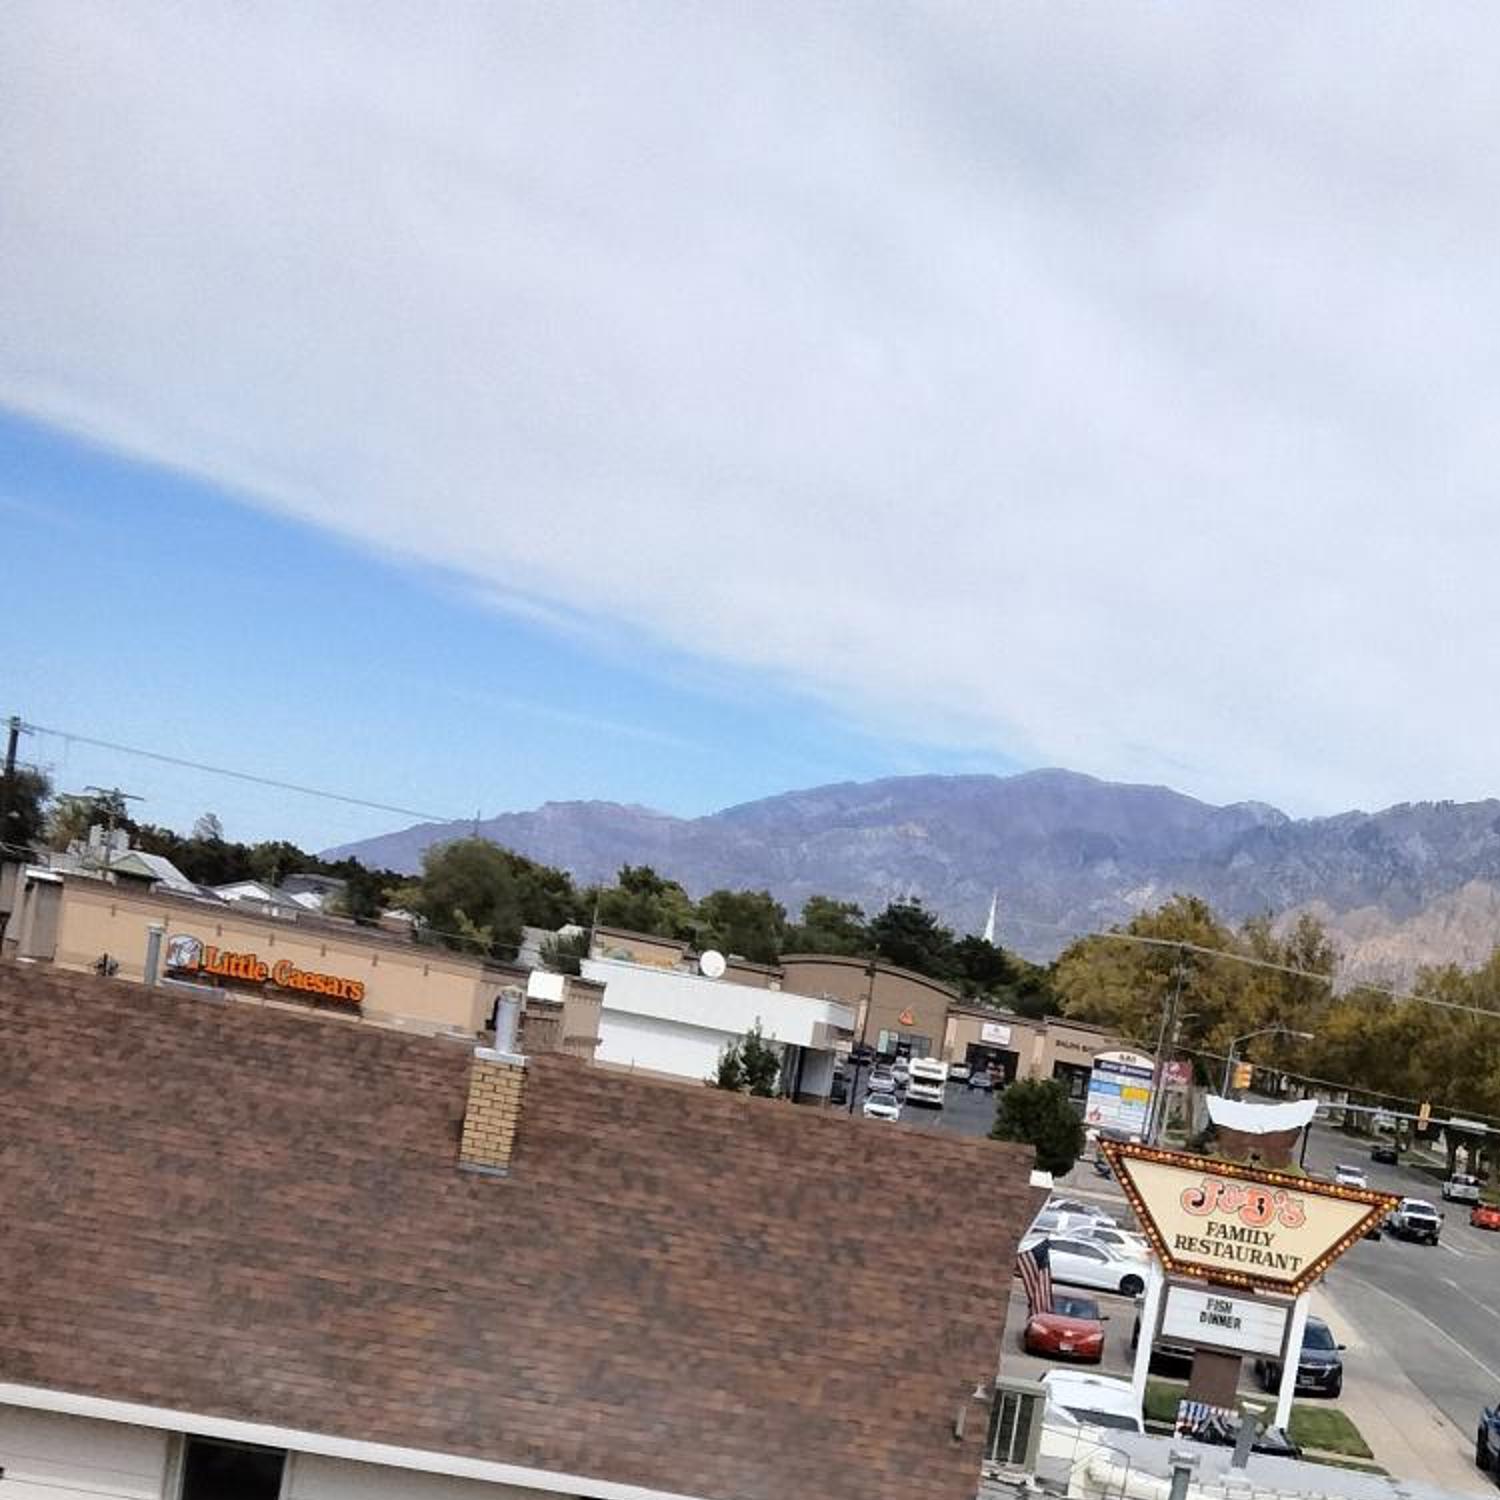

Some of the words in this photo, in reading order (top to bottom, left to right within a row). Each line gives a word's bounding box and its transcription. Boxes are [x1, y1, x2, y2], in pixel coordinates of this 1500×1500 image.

[205, 945, 268, 982] Little
[272, 959, 365, 1003] Caesars
[1206, 1221, 1275, 1247] FAMILY
[1174, 1233, 1303, 1272] RESTAURANT
[1206, 1298, 1233, 1314] FISH
[1199, 1311, 1241, 1331] DINNER
